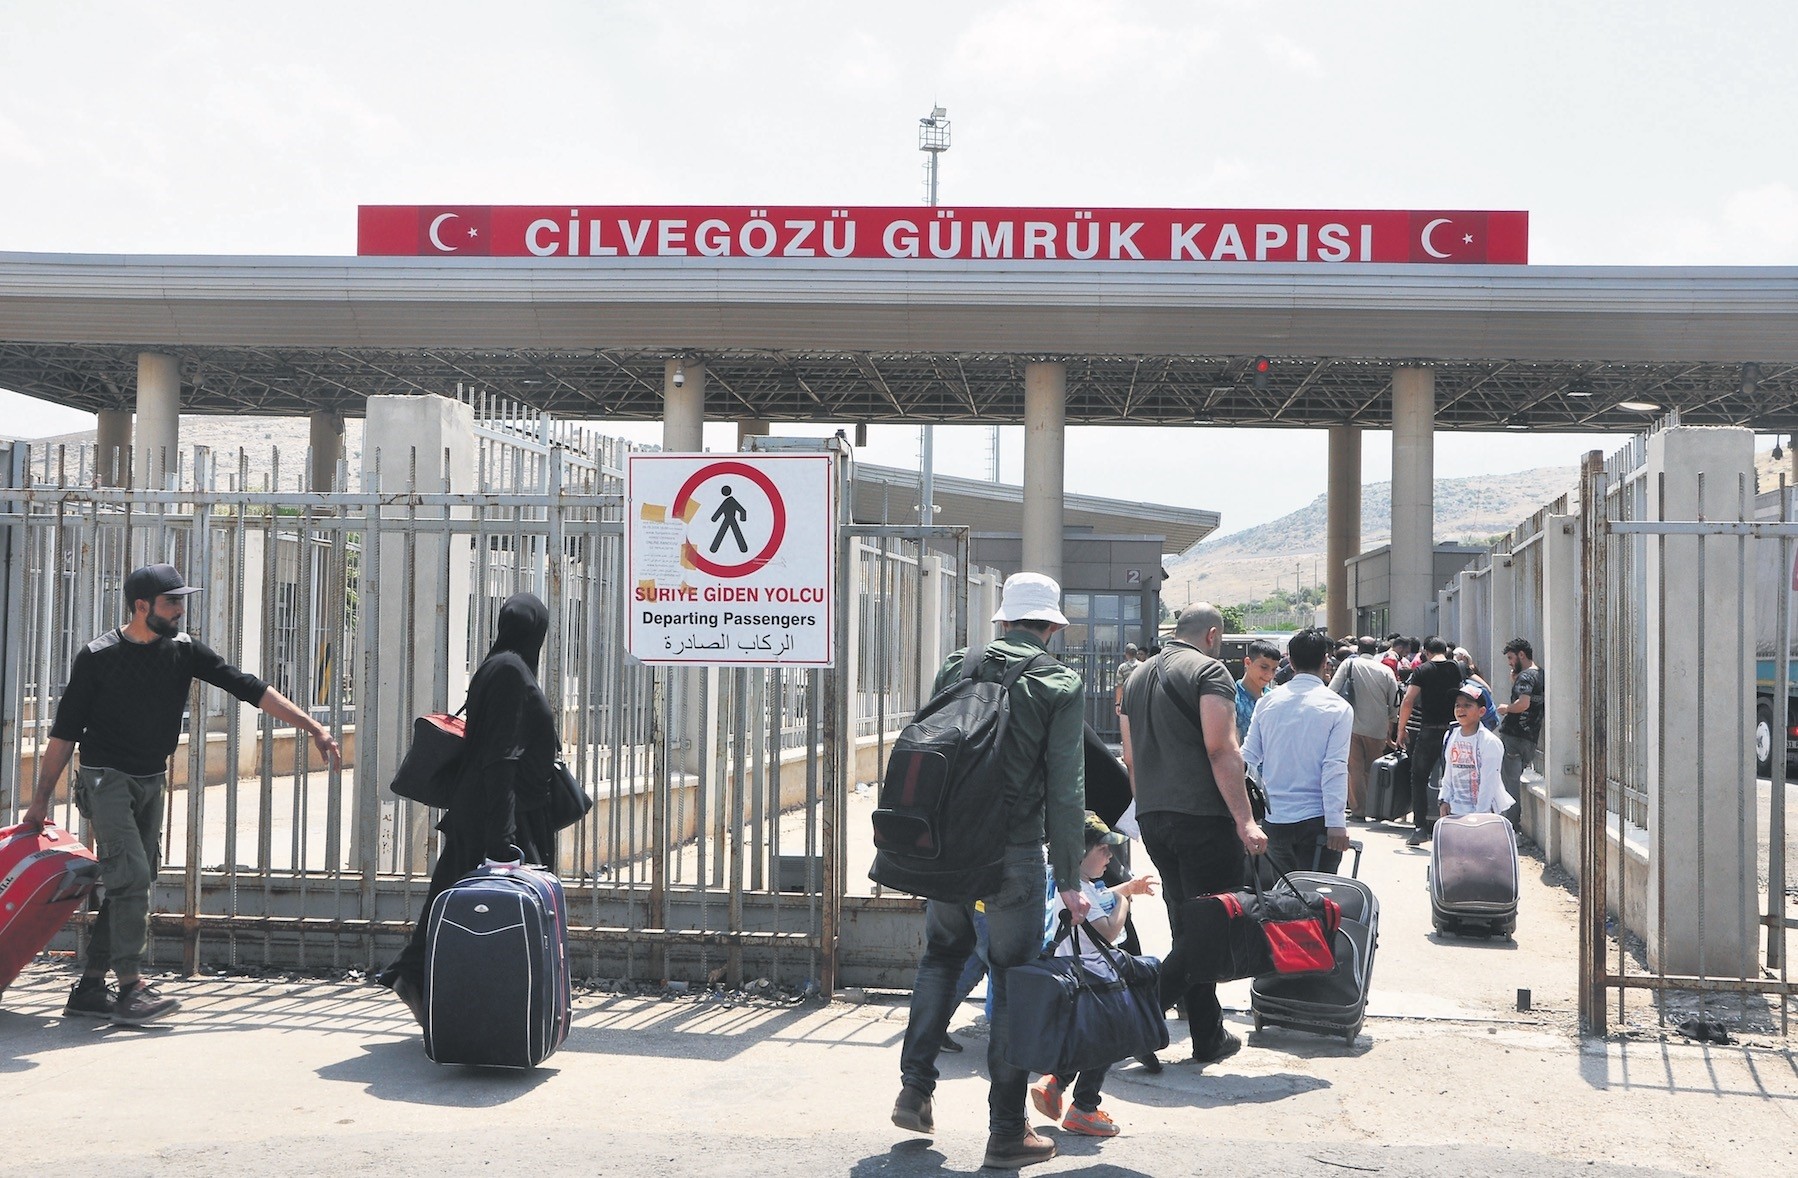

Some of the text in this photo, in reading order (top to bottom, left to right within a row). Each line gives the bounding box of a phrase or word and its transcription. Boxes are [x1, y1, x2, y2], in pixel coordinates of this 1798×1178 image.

[524, 209, 1373, 263] CİLVEGÖZÜ GÜMRÜK KAPISI
[1128, 570, 1140, 583] 2
[703, 583, 758, 602] GİDEN
[764, 587, 824, 603] YOLCU
[642, 611, 816, 629] Departing Passengers
[664, 633, 794, 656] الركاب الصادرة
